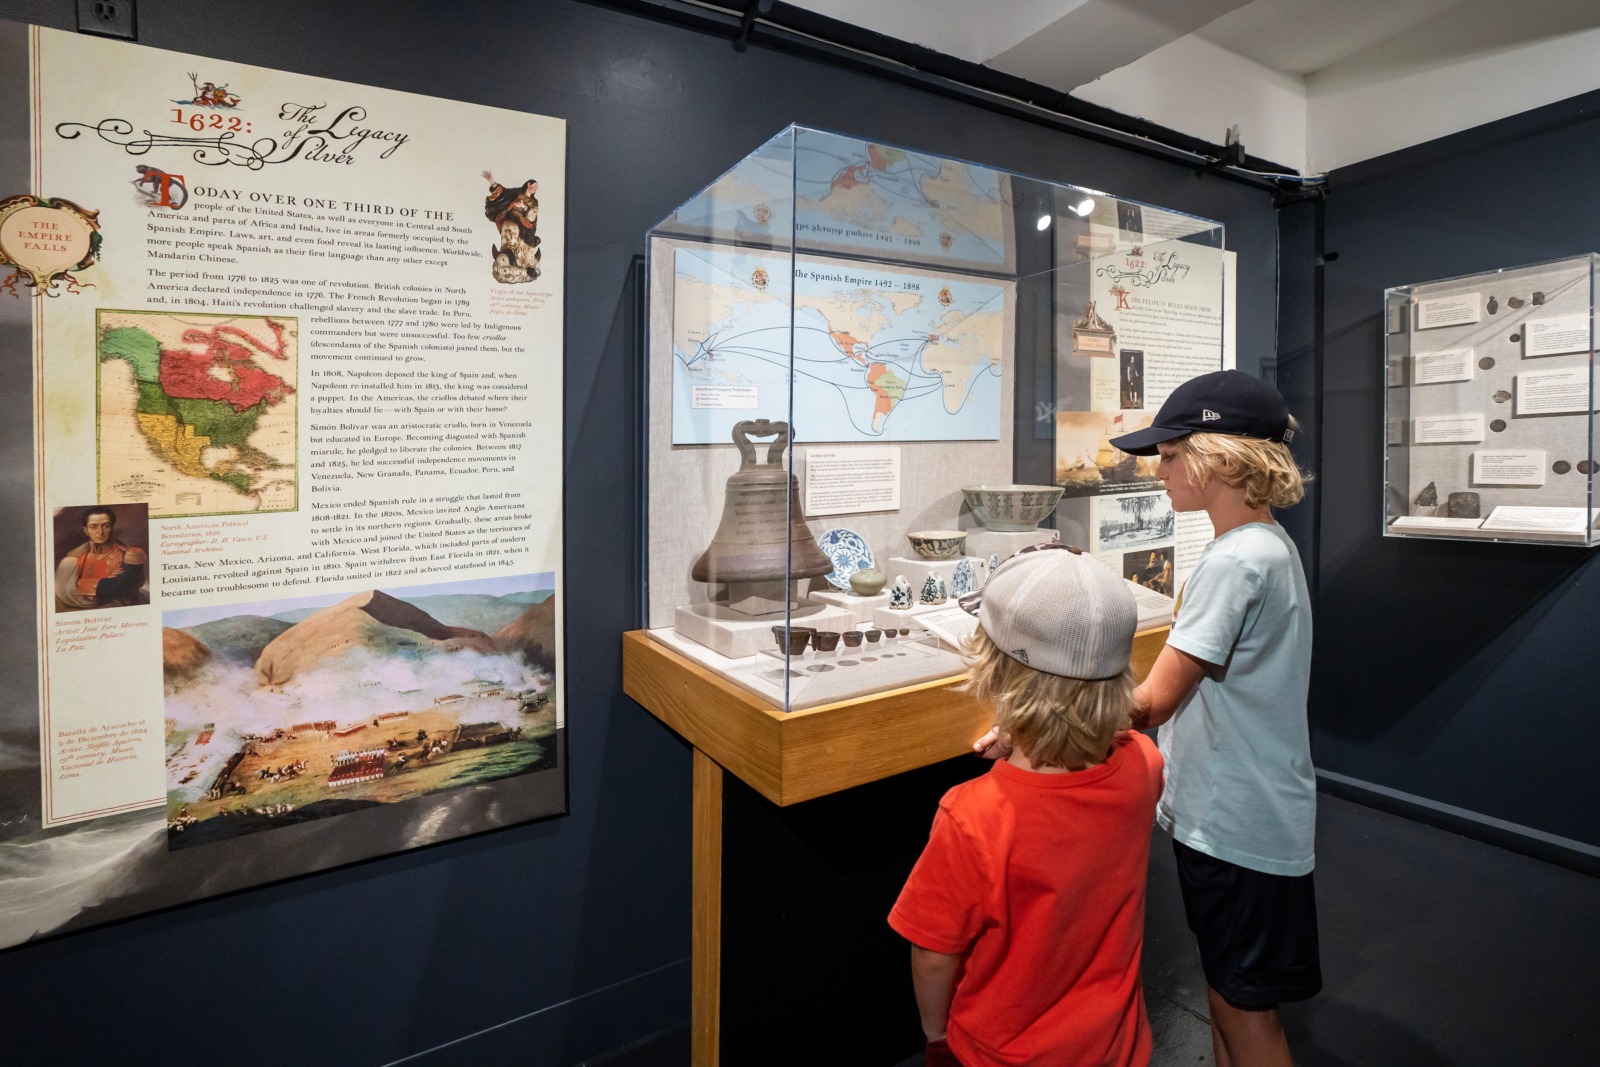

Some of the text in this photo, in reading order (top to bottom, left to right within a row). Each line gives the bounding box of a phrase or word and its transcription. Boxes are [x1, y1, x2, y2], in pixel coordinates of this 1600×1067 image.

[170, 109, 252, 134] 1622:
[279, 102, 410, 159] The Legacy
[282, 125, 308, 149] of
[275, 136, 354, 165] Silver
[250, 192, 296, 206] OVER
[303, 198, 337, 210] ONE
[343, 202, 394, 215] THIRD
[400, 208, 418, 218] OF
[424, 210, 454, 221] THE
[194, 203, 223, 212] people
[238, 206, 252, 214] the
[255, 207, 284, 217] United
[287, 210, 314, 220] States,
[358, 219, 394, 227] everyone
[406, 222, 434, 231] Central
[32, 221, 59, 230] THE
[147, 210, 189, 221] America
[250, 220, 278, 229] Africa
[299, 224, 323, 233] India,
[377, 230, 410, 242] formerly
[412, 236, 444, 244] occupied
[446, 237, 455, 246] by
[18, 231, 72, 241] EMPIRE
[24, 242, 67, 252] FALLS
[148, 250, 238, 264] Mandarin Chinese.
[1125, 258, 1147, 269] 1622:
[795, 270, 808, 278] The
[811, 271, 842, 282] Spanish
[845, 276, 872, 286] Empire
[311, 316, 350, 324] rebellions
[352, 317, 385, 325] between
[473, 322, 481, 331] by
[484, 323, 521, 332] Indigenous
[347, 370, 383, 379] Napoleon
[385, 371, 415, 380] deposed
[431, 371, 448, 380] king
[459, 372, 479, 380] Spain
[464, 505, 486, 514] Anglo
[56, 635, 97, 644] Legislative
[101, 721, 137, 731] Ayacucho
[78, 733, 117, 742] Diciembre
[59, 761, 93, 771] Nacional
